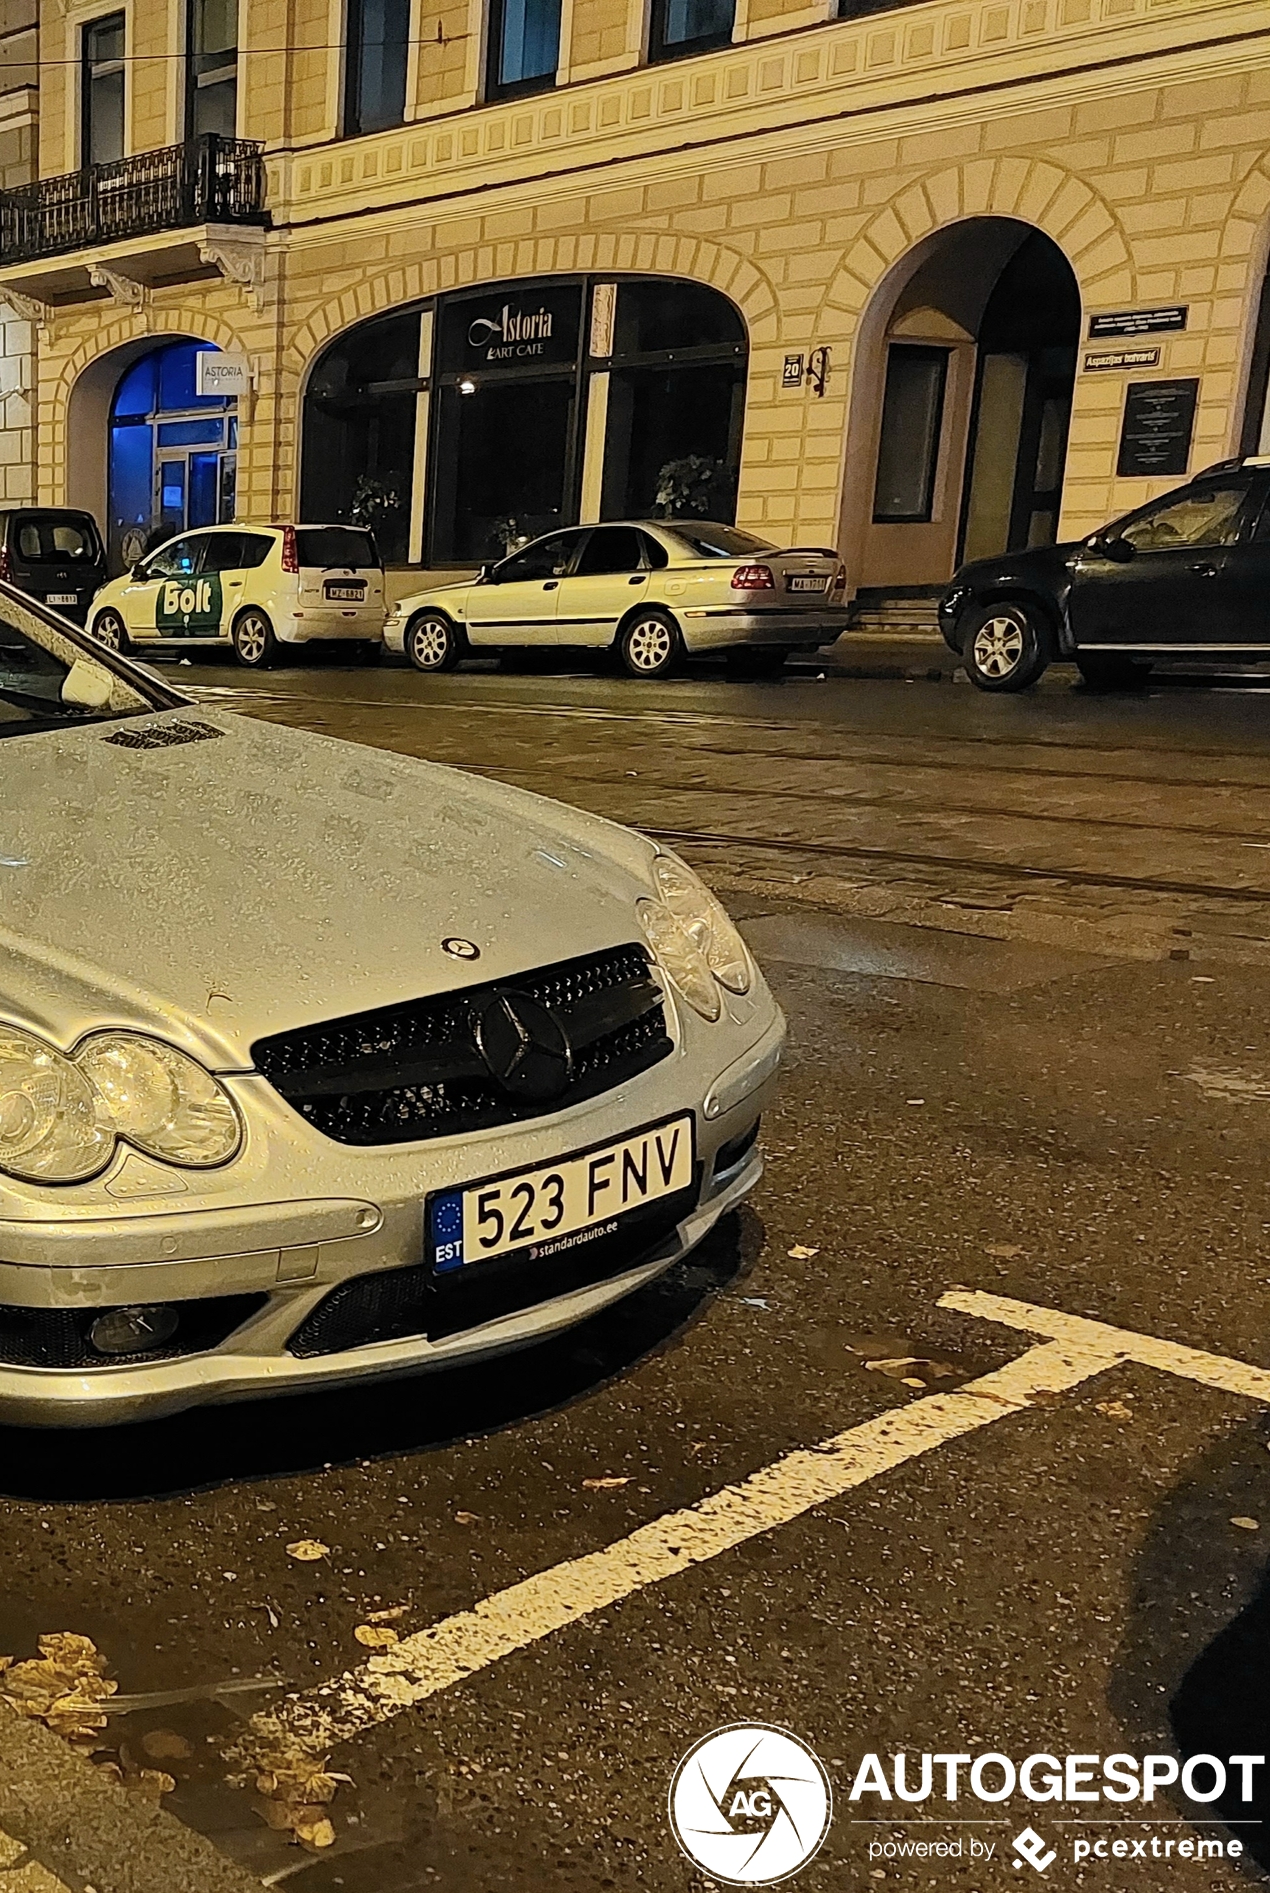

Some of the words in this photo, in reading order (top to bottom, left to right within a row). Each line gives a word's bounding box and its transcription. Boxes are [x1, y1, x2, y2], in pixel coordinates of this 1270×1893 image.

[468, 303, 552, 346] Astoria
[205, 366, 243, 377] ASTORIA
[784, 363, 799, 377] 20
[477, 1173, 564, 1248] 523
[588, 1128, 680, 1218] FNV
[435, 1240, 463, 1263] EST
[538, 1221, 618, 1258] standardauto.ee
